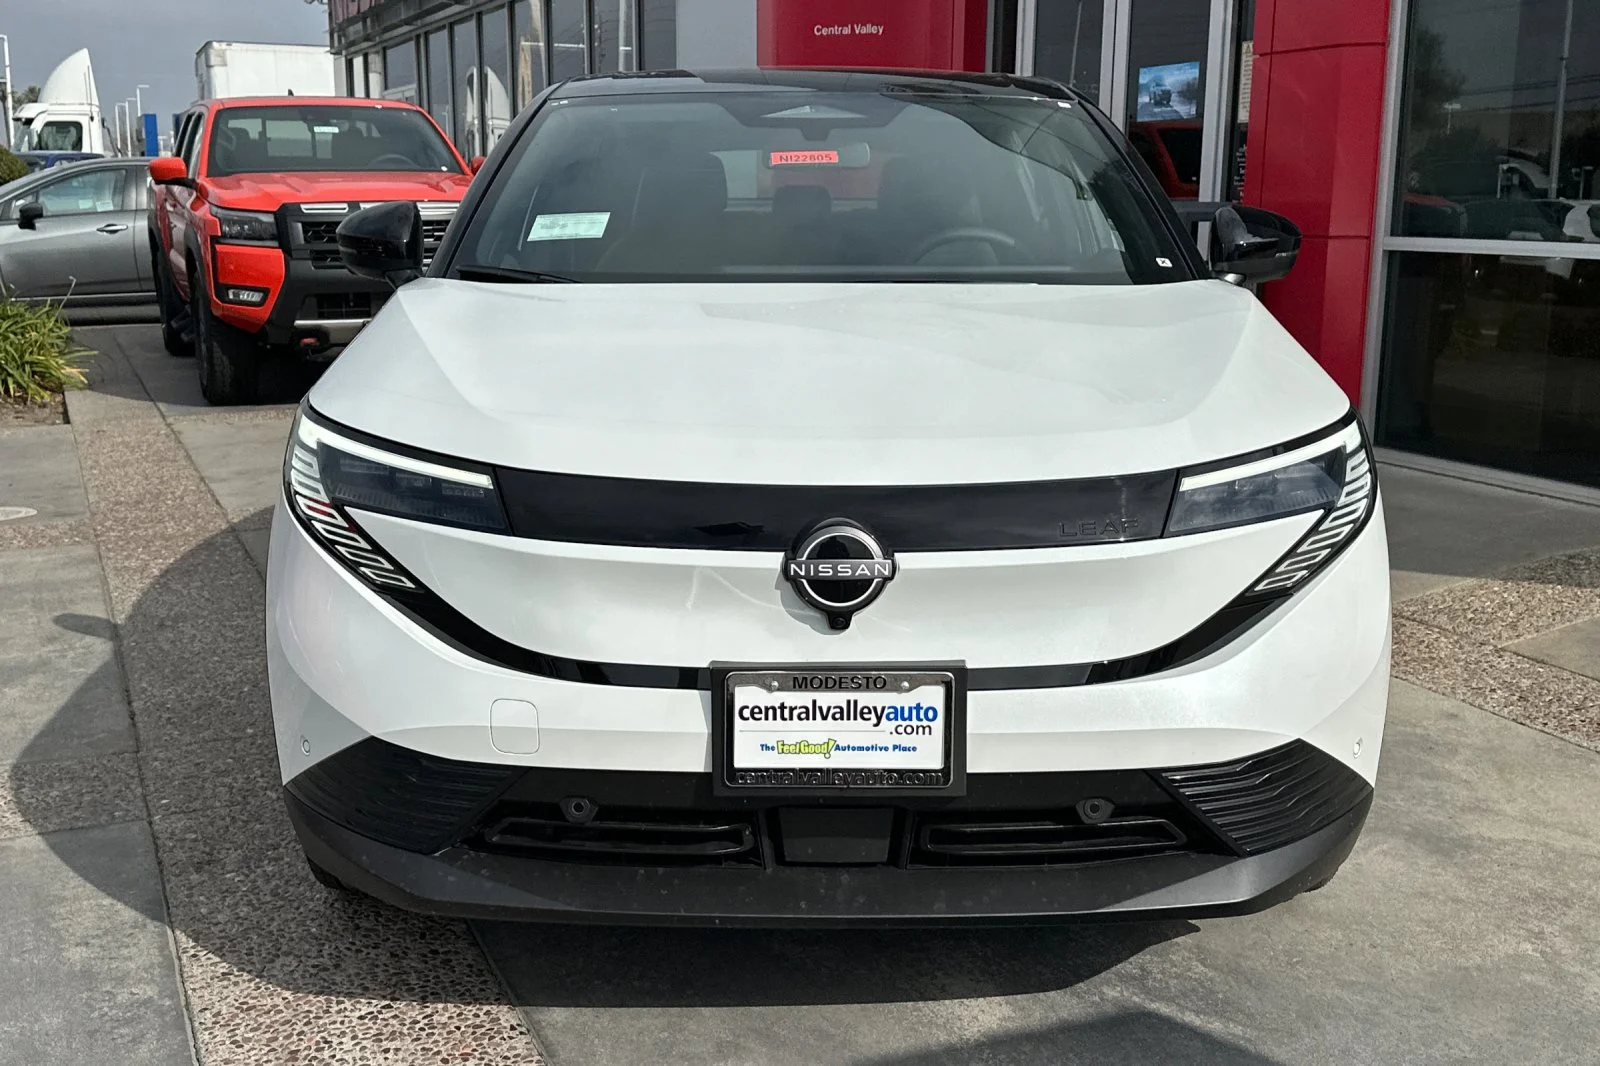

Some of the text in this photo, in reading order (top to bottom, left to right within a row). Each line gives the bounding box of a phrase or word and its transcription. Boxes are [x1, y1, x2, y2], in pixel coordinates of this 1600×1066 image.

[814, 23, 884, 36] Central Valley
[1059, 518, 1138, 537] LEAF
[790, 563, 889, 577] NISSAN
[793, 676, 888, 690] MODESTO
[738, 699, 938, 727] centralvalleyauto
[889, 724, 932, 736] .com
[760, 743, 775, 752] The
[835, 743, 889, 752] Automotive
[892, 743, 918, 752] Place
[736, 768, 944, 787] centralvalleyauto.com
